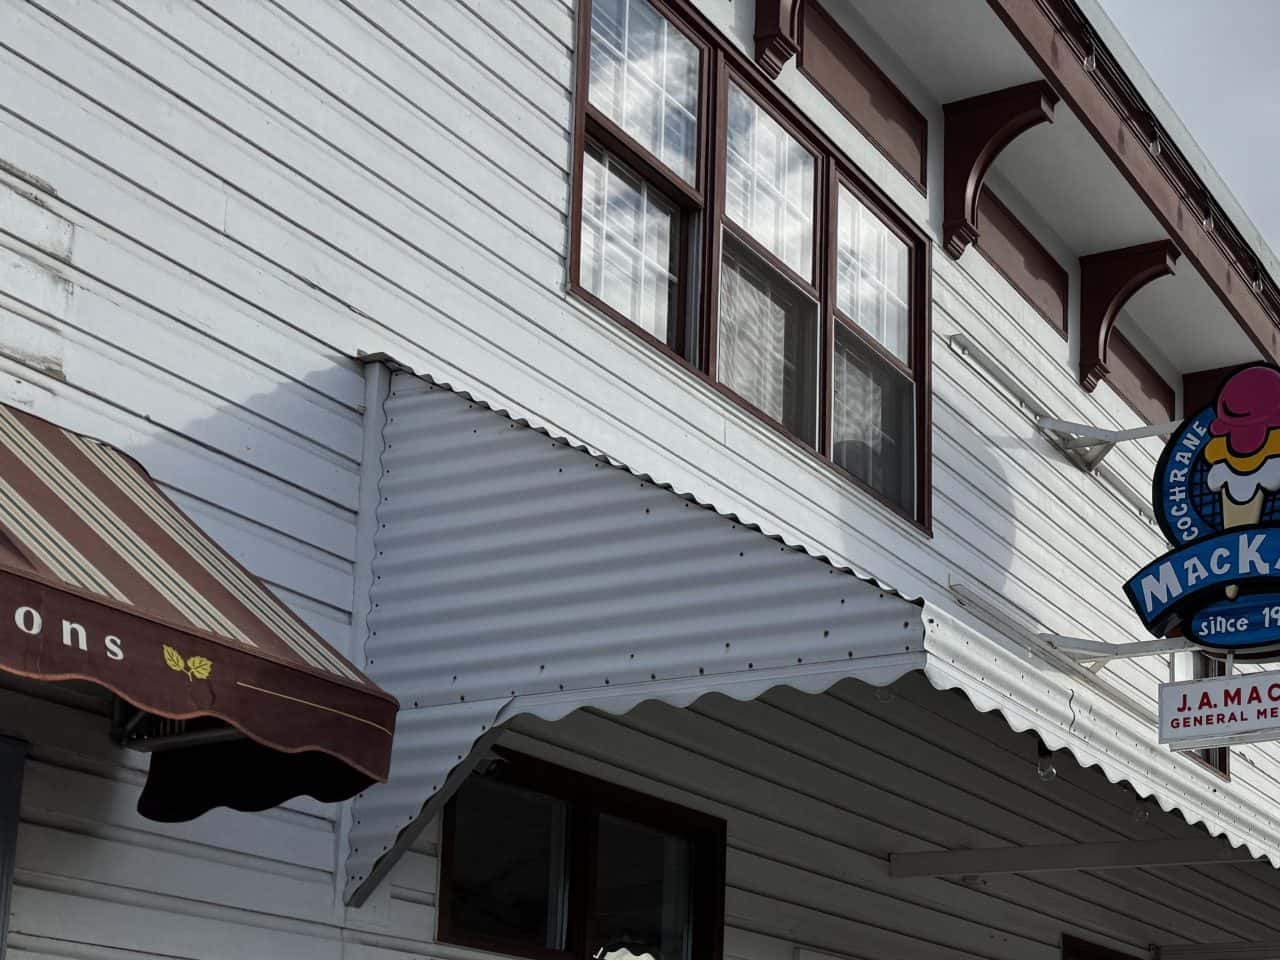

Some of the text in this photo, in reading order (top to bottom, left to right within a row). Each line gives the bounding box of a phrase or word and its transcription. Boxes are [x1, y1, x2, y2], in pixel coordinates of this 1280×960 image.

[1169, 420, 1208, 542] COCHRANE
[1199, 614, 1249, 636] since
[1171, 711, 1249, 729] GENERAL
